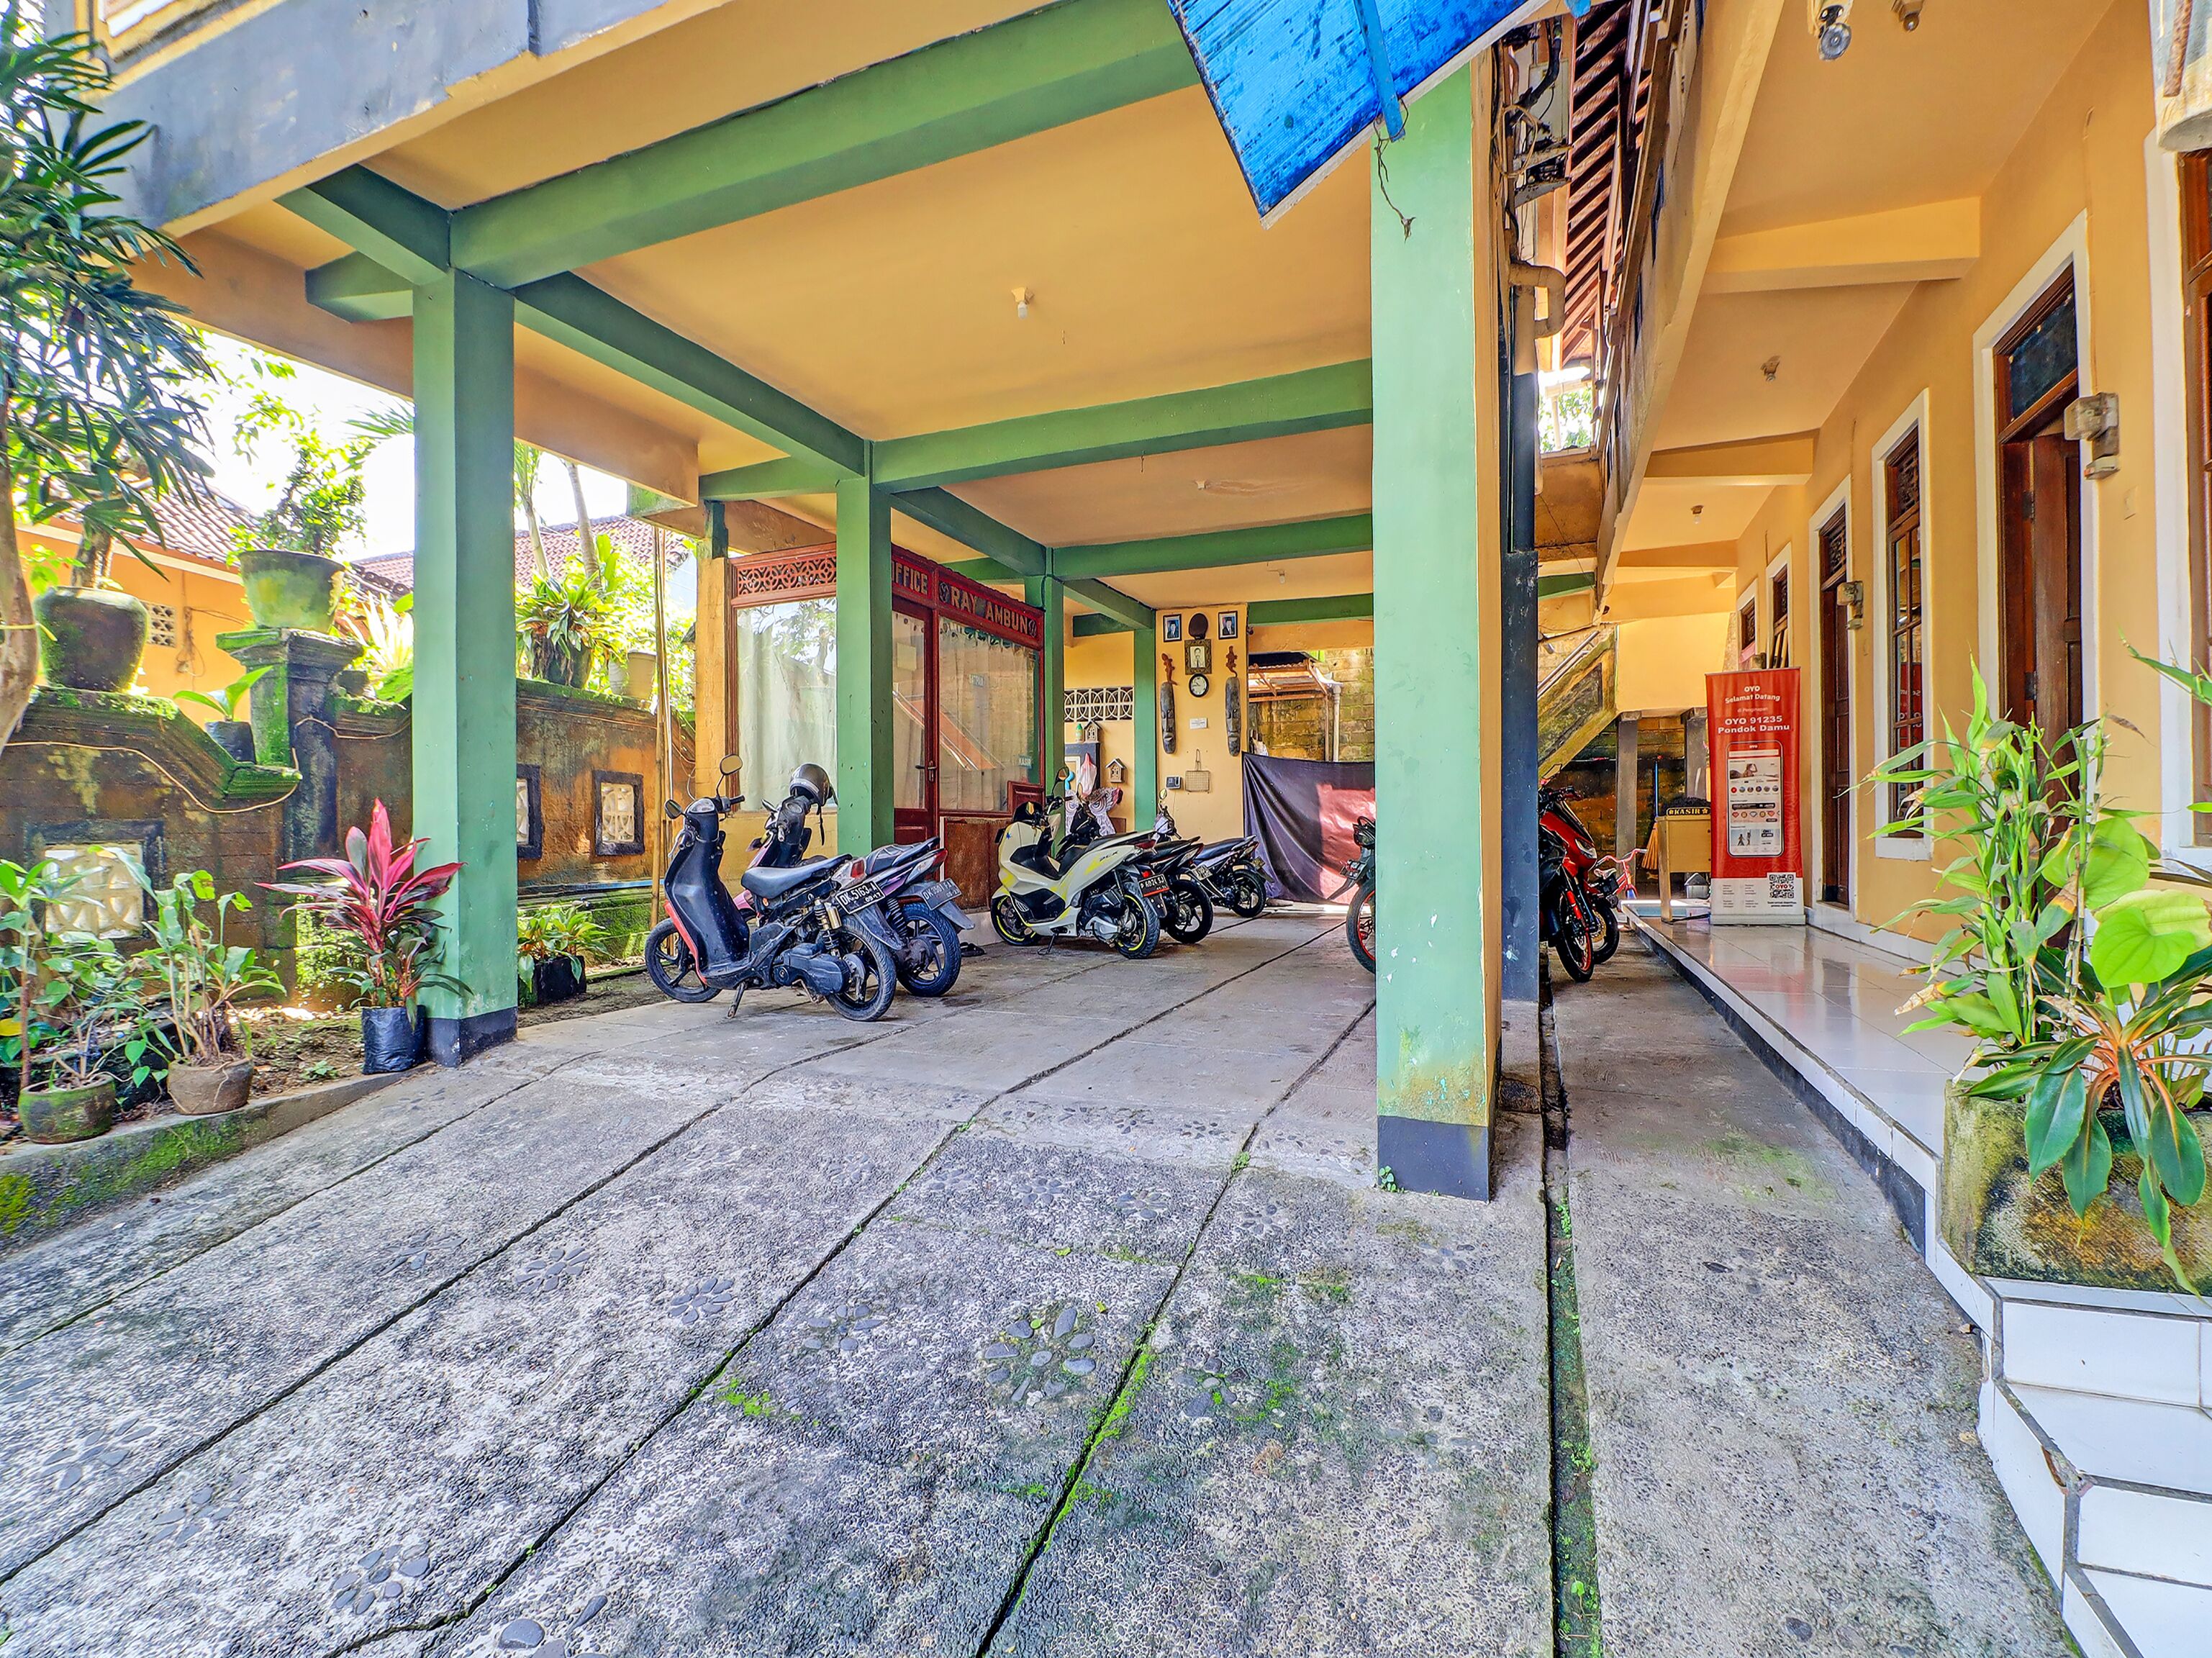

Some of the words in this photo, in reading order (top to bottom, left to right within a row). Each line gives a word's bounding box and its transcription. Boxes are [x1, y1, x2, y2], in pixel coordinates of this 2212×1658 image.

[951, 586, 977, 615] RAY
[986, 601, 1028, 635] AMBUN
[1725, 694, 1754, 704] Selamat
[1750, 715, 1782, 724] 91235
[1718, 725, 1756, 734] Pondok
[839, 891, 853, 905] DK
[851, 884, 870, 900] 5163
[923, 888, 934, 900] DK
